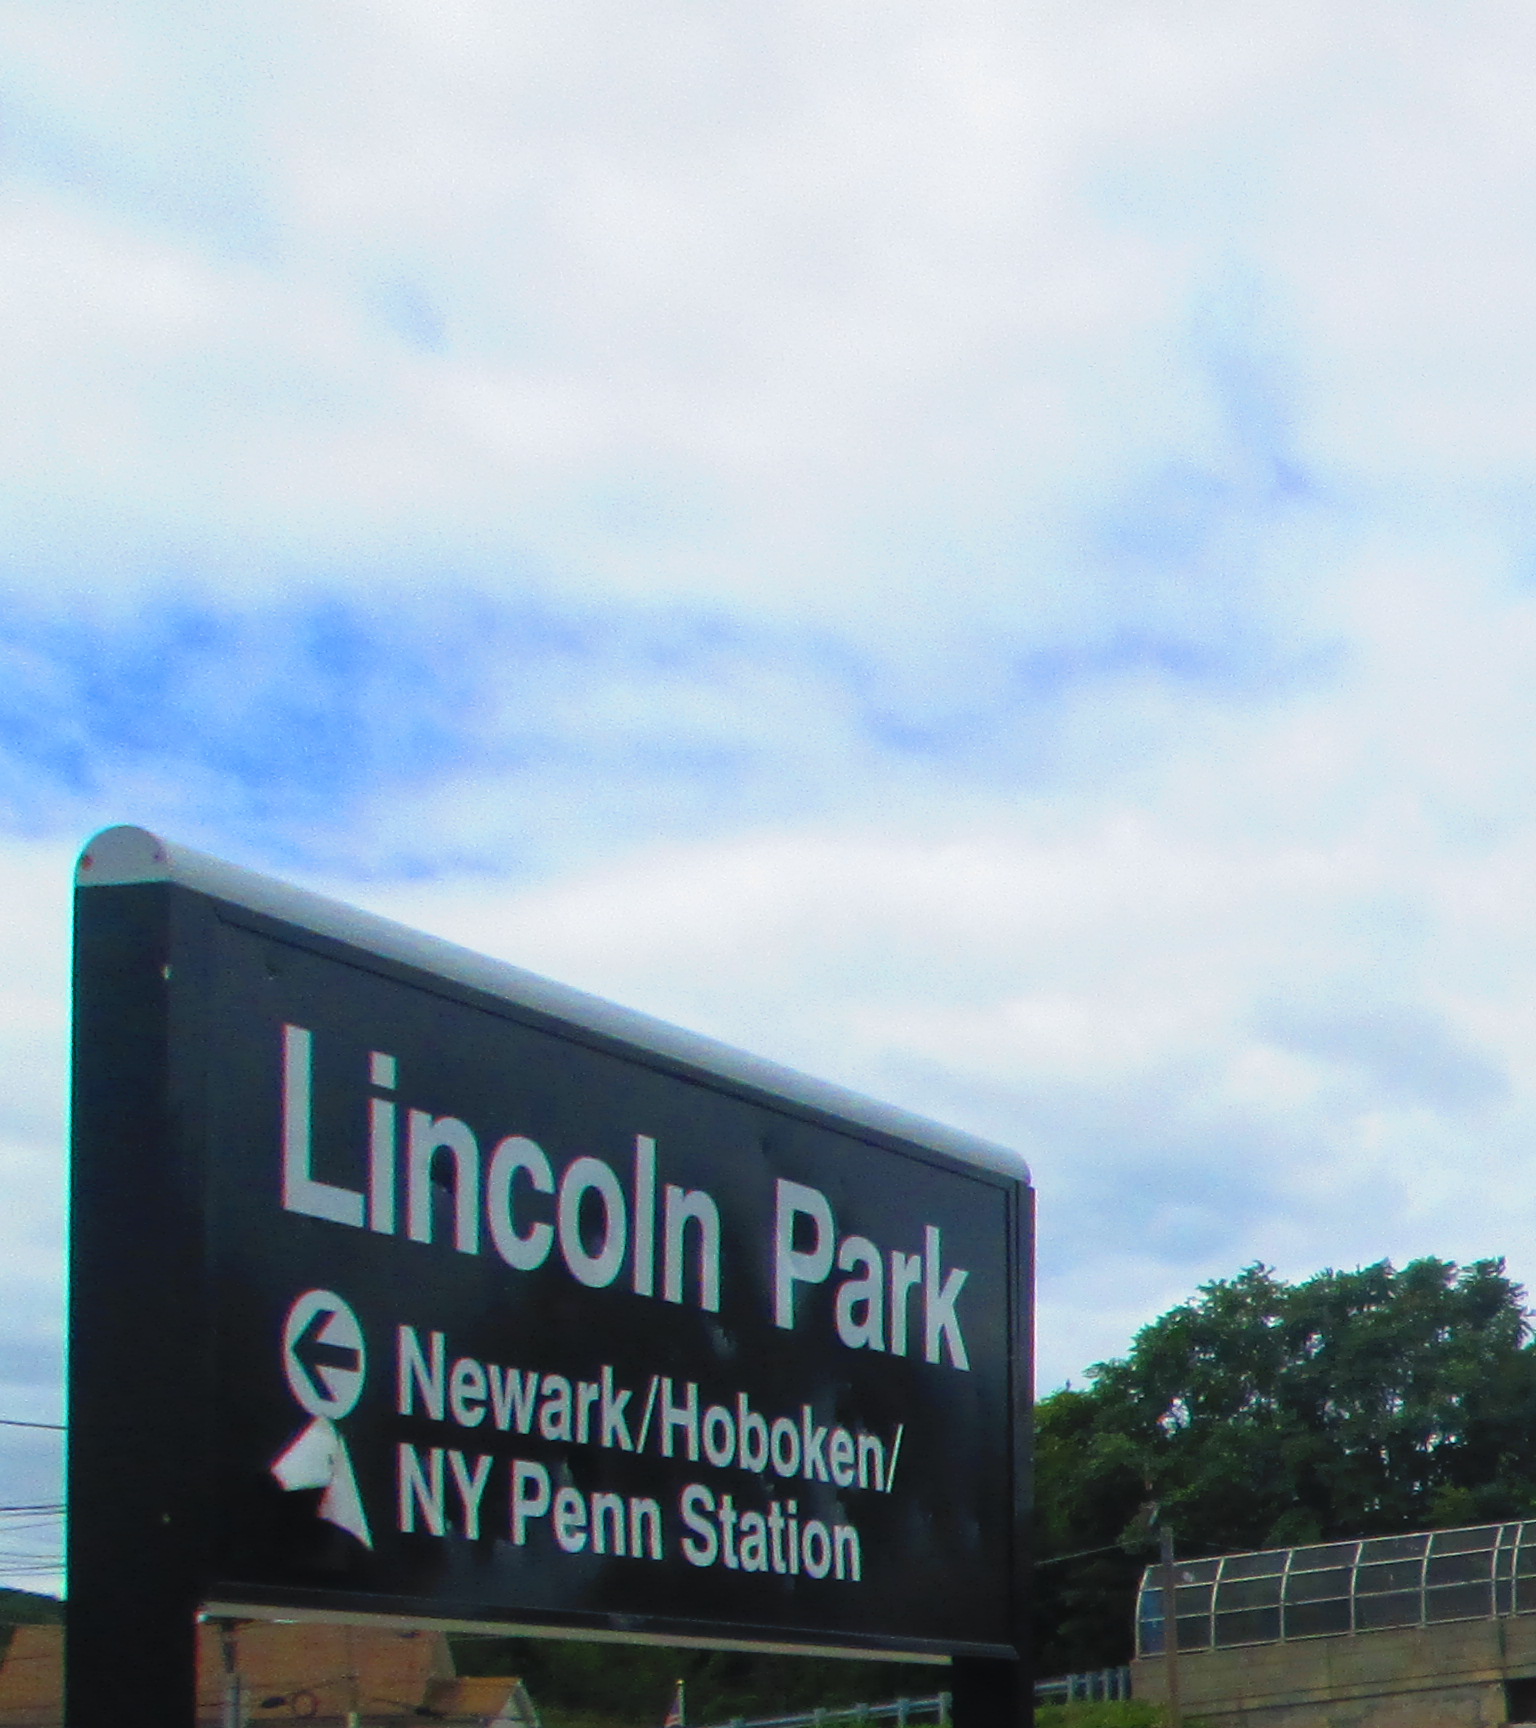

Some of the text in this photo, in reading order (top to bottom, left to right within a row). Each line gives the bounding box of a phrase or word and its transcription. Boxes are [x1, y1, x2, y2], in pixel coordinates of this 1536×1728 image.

[282, 1023, 971, 1371] Lincoln Park
[399, 1325, 904, 1494] Newark/Hoboken/
[399, 1442, 862, 1582] NY Penn Station
